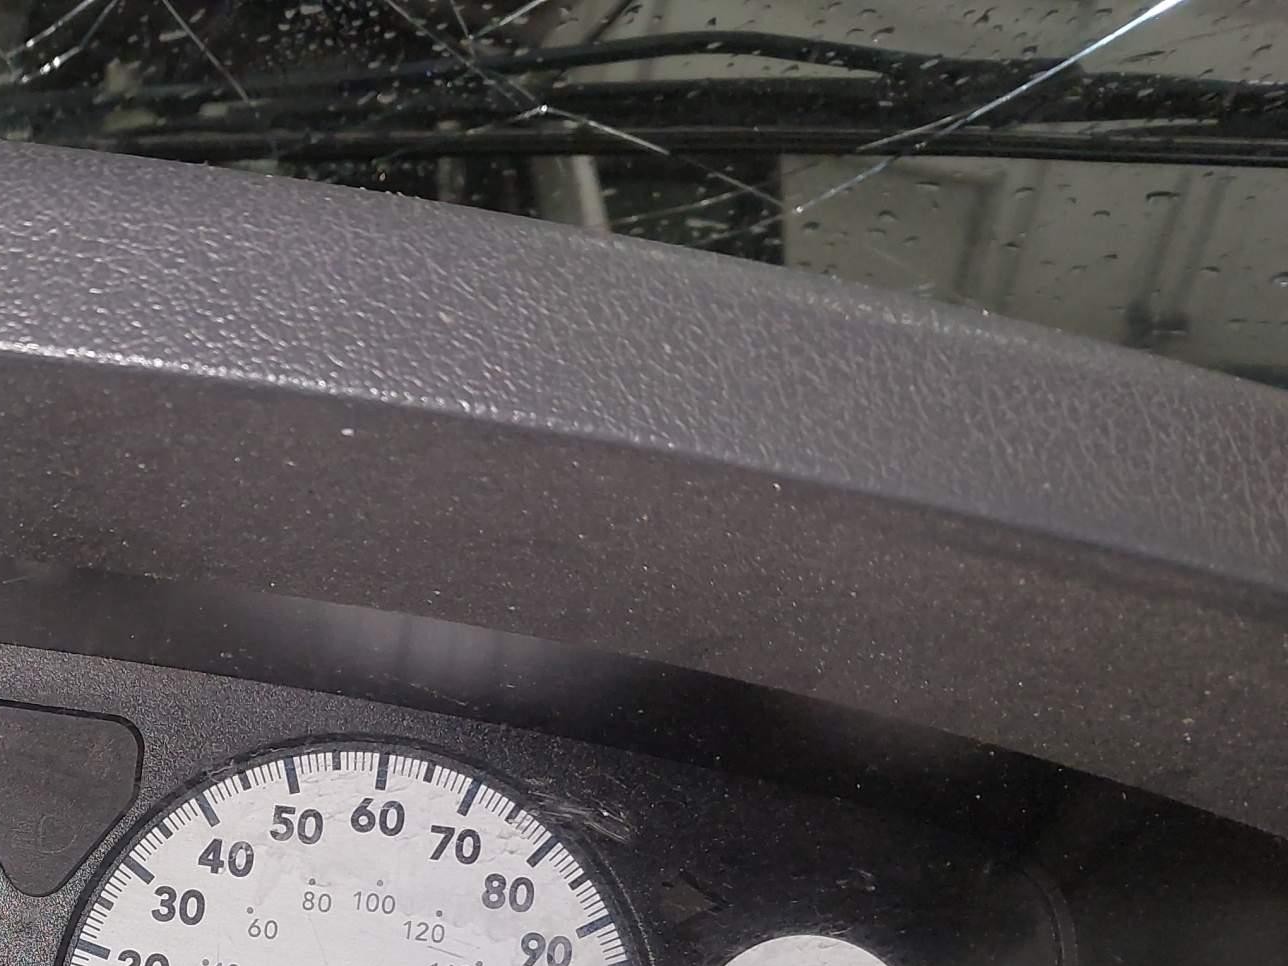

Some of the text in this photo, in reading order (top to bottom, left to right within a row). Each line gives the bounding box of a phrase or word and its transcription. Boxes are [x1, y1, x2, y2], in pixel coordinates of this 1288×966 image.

[270, 804, 323, 845] 50
[350, 798, 405, 836] 60
[198, 838, 254, 878] 40
[429, 825, 481, 864] 70
[152, 886, 205, 926] 30
[302, 891, 331, 913] 80
[353, 891, 396, 914] 100
[482, 873, 535, 913] 80
[248, 919, 278, 939] 60
[403, 920, 445, 944] 120
